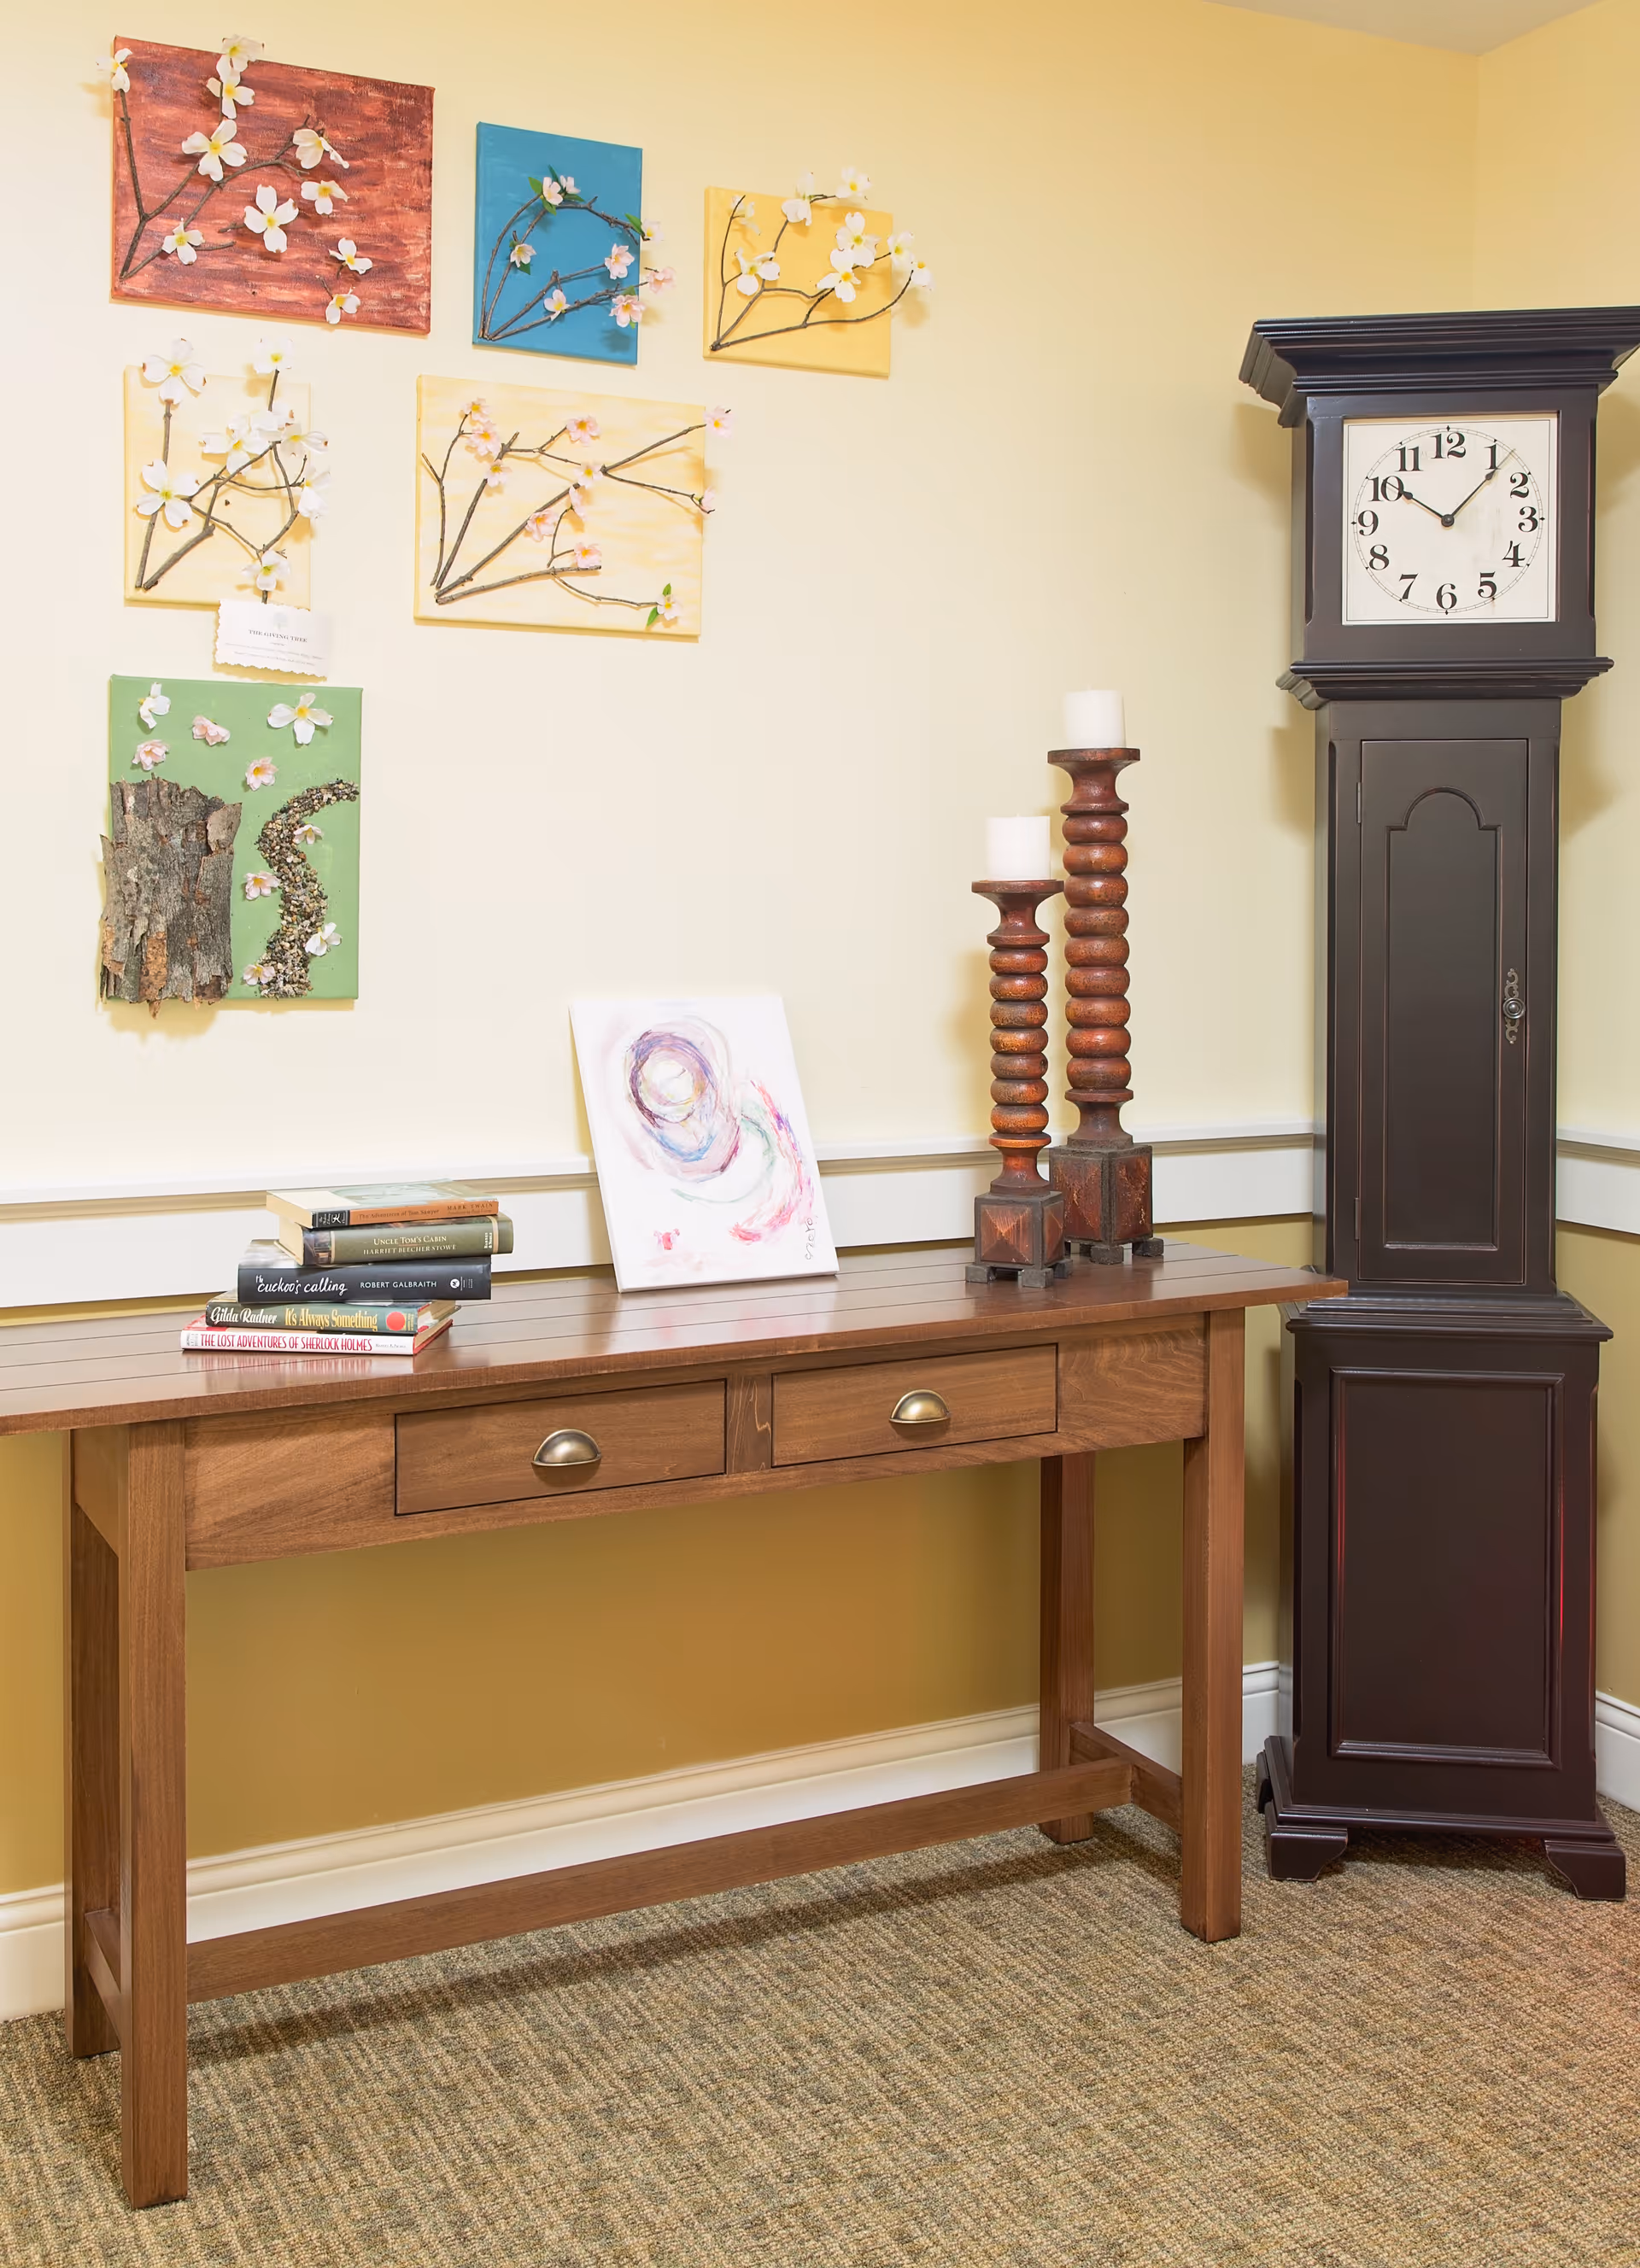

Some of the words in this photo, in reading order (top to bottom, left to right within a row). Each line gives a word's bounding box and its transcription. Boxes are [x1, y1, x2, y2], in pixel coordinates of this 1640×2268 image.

[1431, 432, 1467, 459] 12
[1485, 444, 1501, 470] 1
[1396, 446, 1424, 472] 11
[1368, 476, 1404, 502] 10
[1510, 472, 1530, 499] 2
[1357, 510, 1379, 536] 9
[1518, 506, 1538, 532] 3
[1368, 544, 1390, 570] 8
[1502, 541, 1526, 568] 4
[1399, 573, 1419, 599] 7
[1436, 583, 1457, 610] 6
[1478, 571, 1497, 599] 5
[257, 1277, 302, 1295] cuckoo's
[303, 1277, 348, 1296] calling
[210, 1306, 239, 1325] Gilda
[240, 1307, 278, 1324] Radner
[284, 1307, 297, 1326] It's
[299, 1307, 330, 1330] Always
[331, 1308, 378, 1331] Something
[201, 1334, 215, 1347] THE
[217, 1334, 236, 1347] LOST
[237, 1335, 287, 1348] ADVENTURES
[289, 1336, 300, 1349] OF
[301, 1336, 339, 1350] SHERLOCK
[342, 1338, 372, 1351] HOLMES
